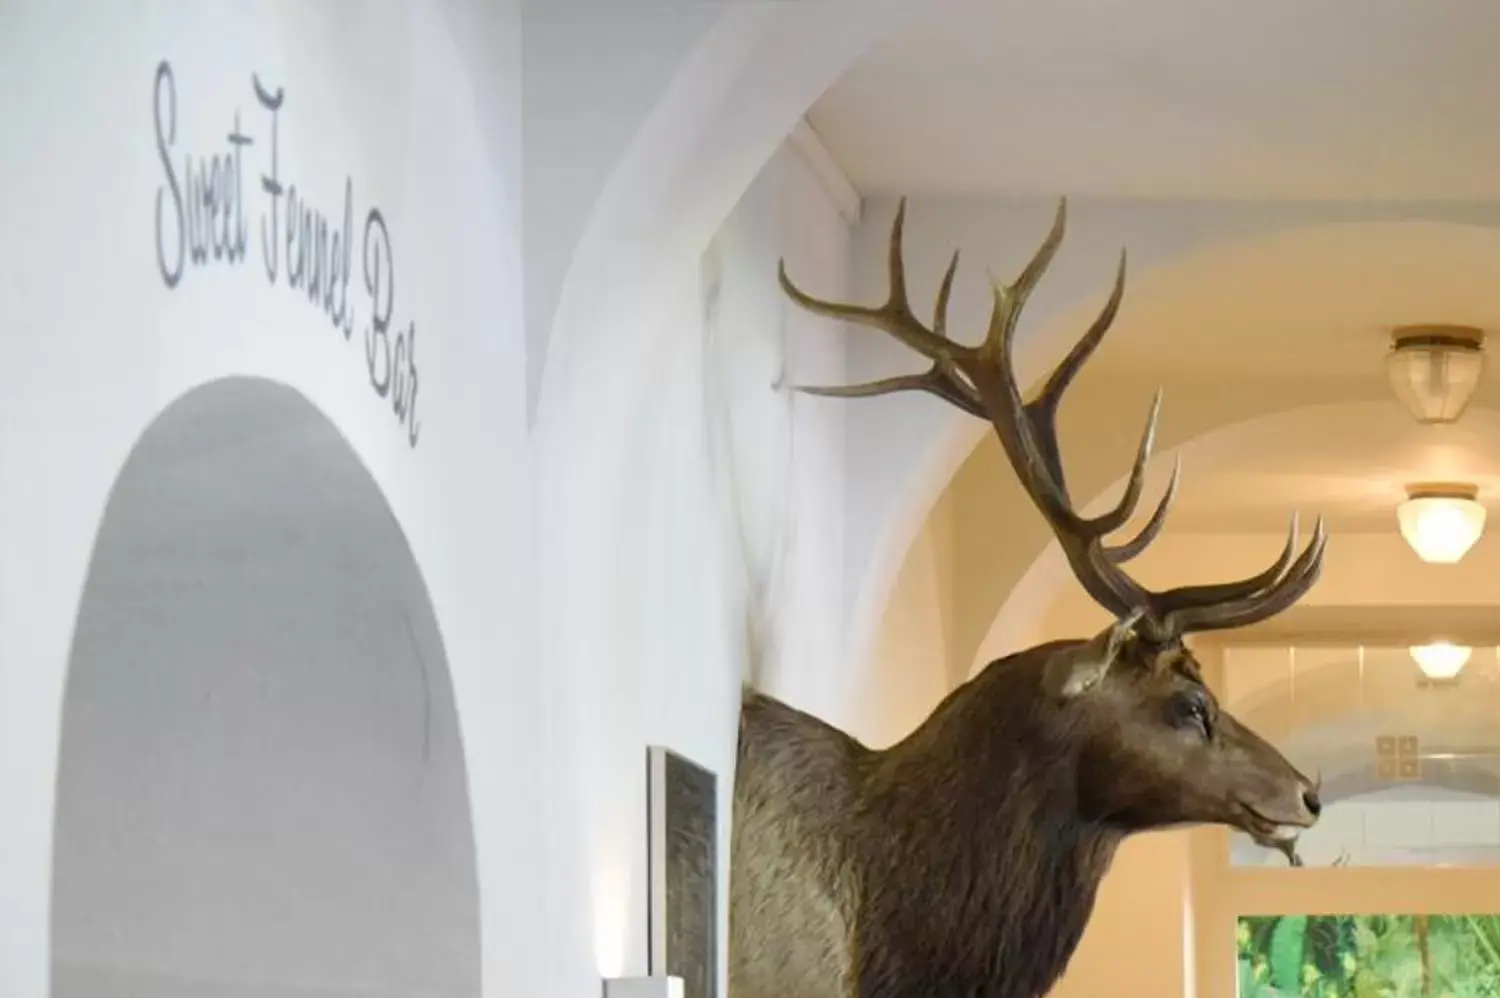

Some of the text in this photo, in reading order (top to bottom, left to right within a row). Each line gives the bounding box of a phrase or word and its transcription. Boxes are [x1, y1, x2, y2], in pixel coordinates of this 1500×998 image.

[154, 59, 420, 448] Sweet Fennel Bar
